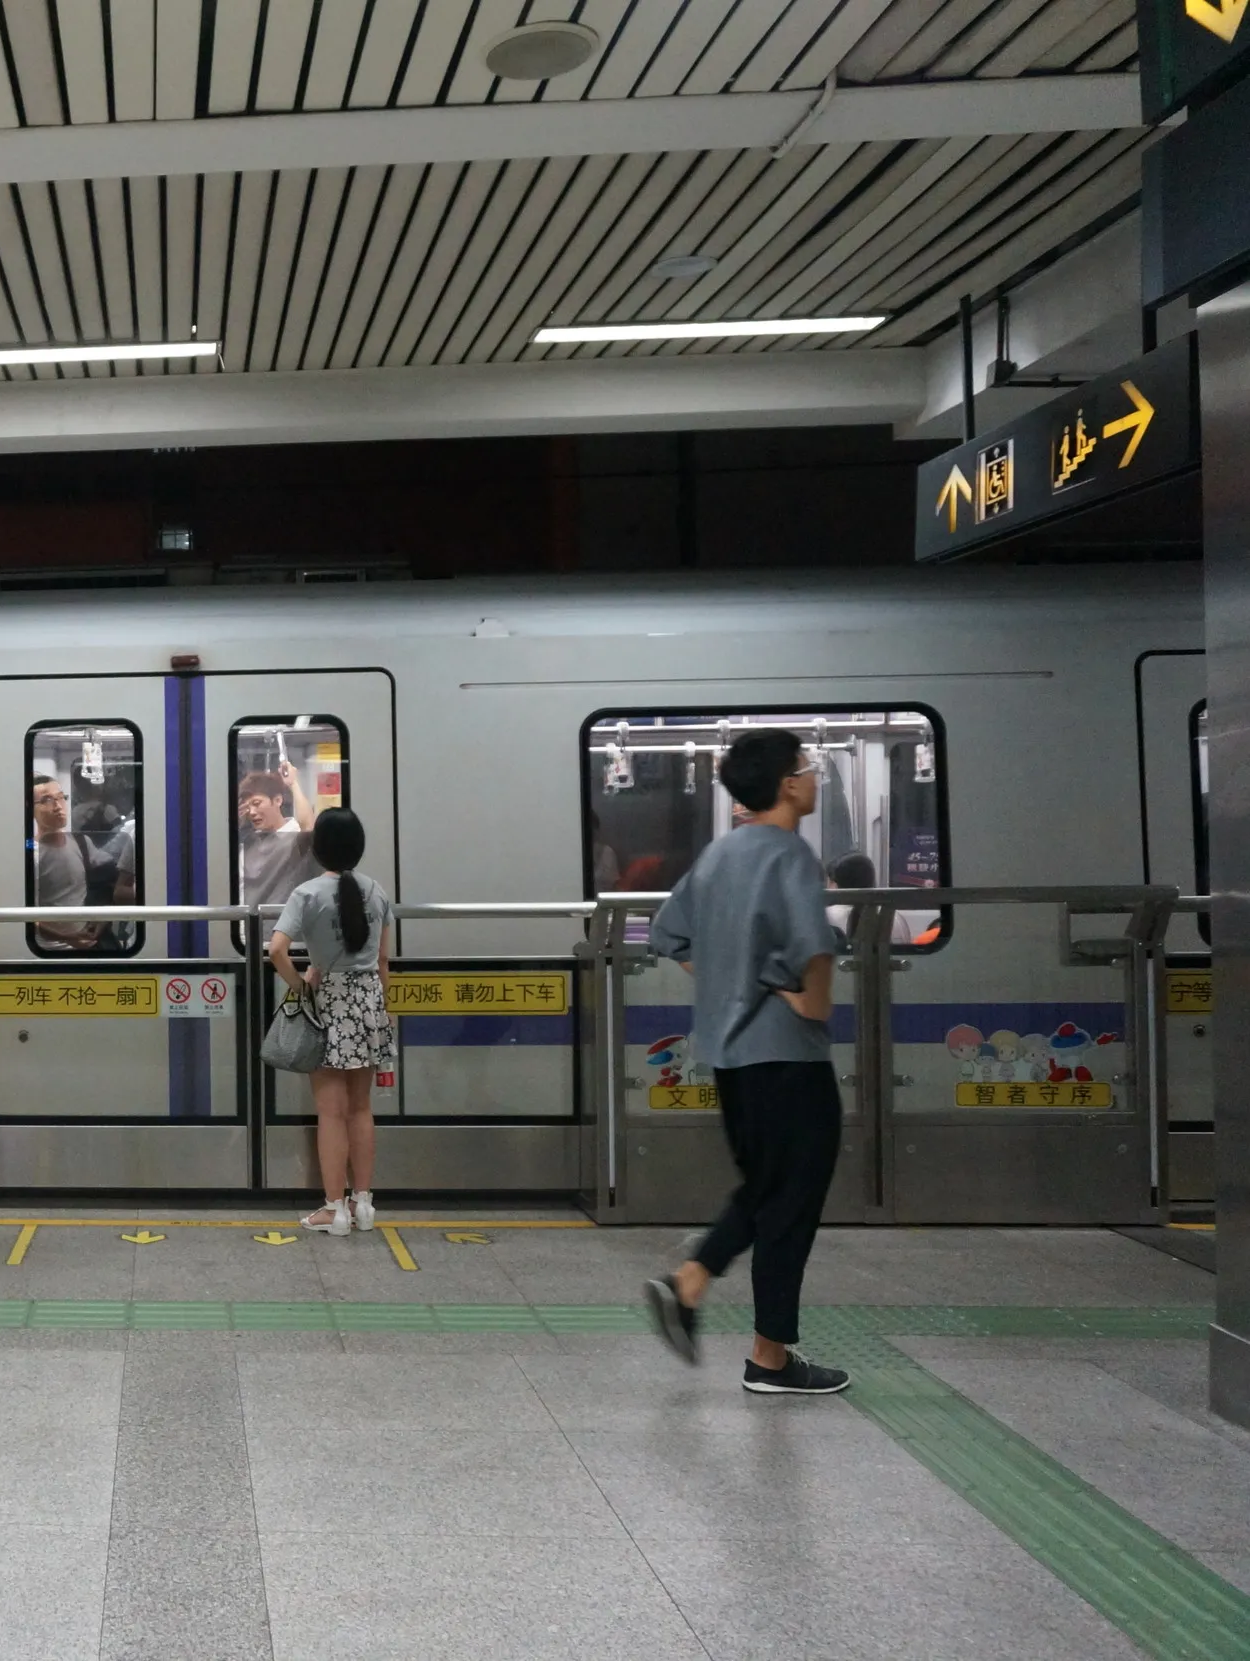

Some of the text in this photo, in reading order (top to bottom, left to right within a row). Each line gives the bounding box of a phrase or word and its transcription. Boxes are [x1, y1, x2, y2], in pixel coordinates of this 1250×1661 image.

[58, 986, 152, 1006] 不抢一扇门
[455, 983, 556, 1004] 请勿上下车
[667, 1087, 719, 1107] 文明
[975, 1084, 1093, 1105] 智者守序
